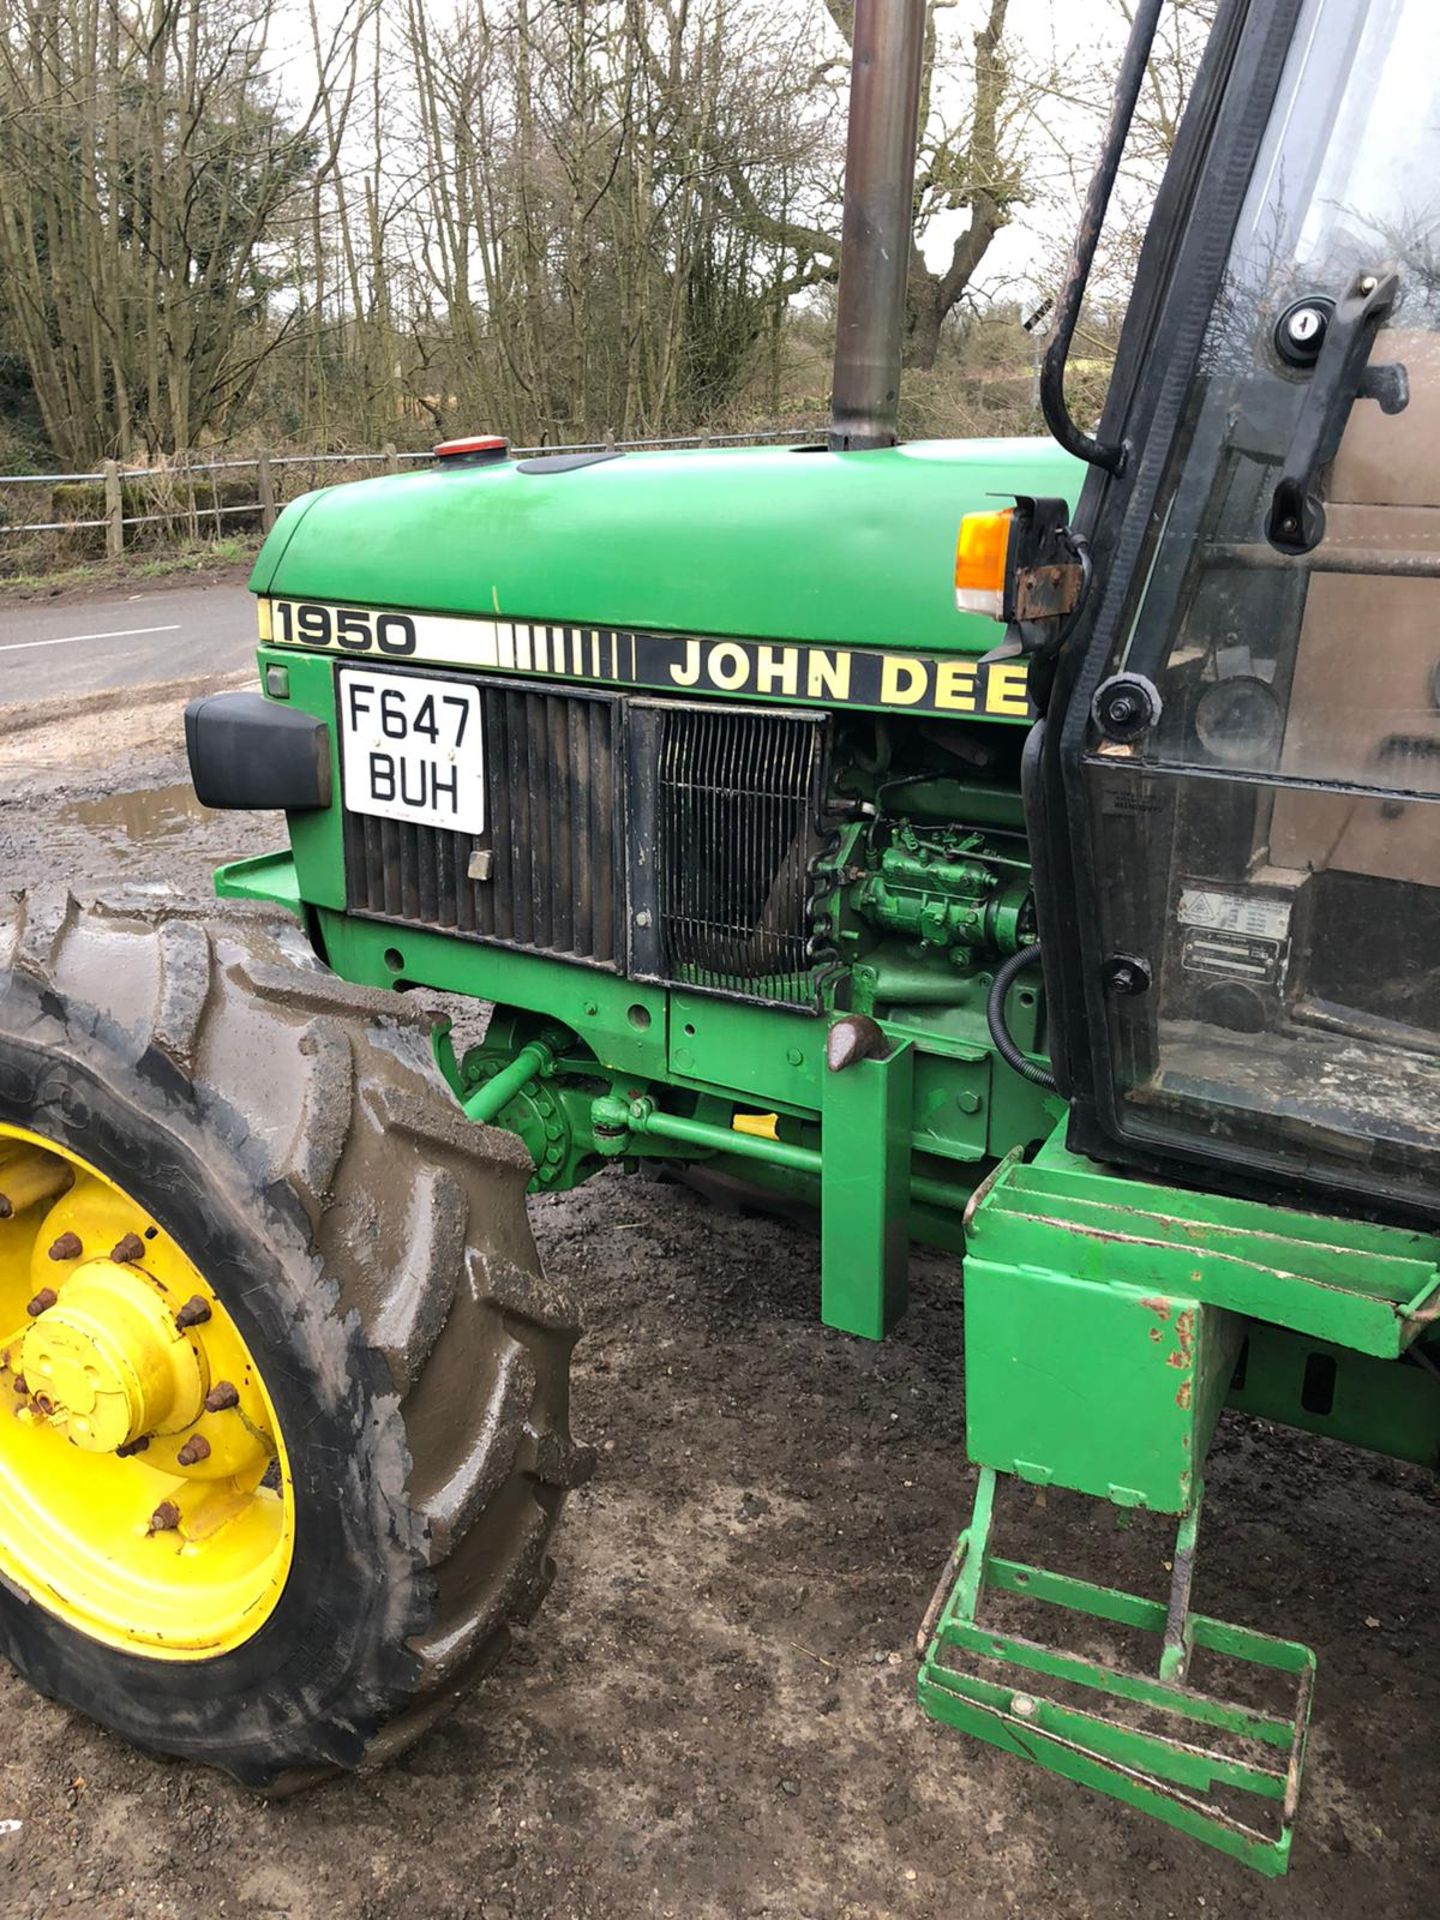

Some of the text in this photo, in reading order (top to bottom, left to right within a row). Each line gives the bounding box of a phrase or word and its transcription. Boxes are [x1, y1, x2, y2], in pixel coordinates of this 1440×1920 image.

[277, 603, 416, 655] 1950
[669, 640, 851, 700] JOHN
[349, 684, 469, 747] F647
[370, 752, 458, 814] BUH
